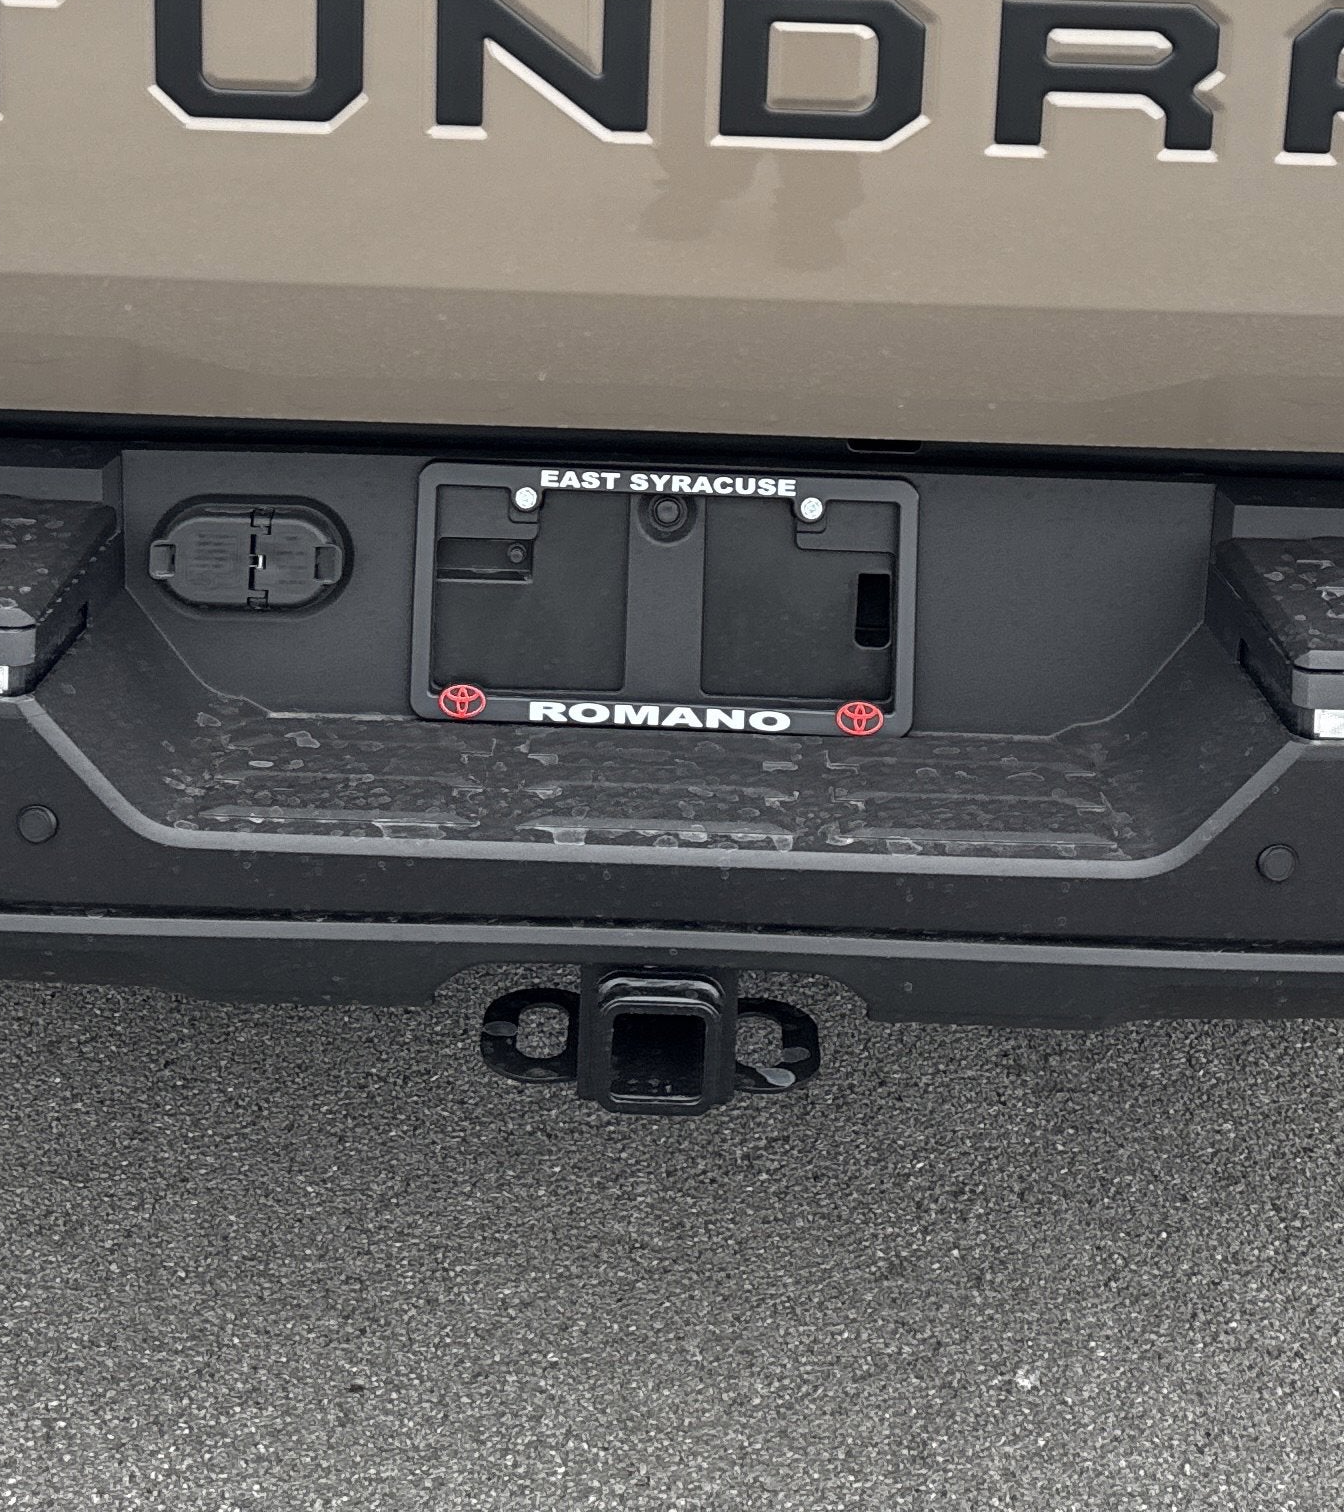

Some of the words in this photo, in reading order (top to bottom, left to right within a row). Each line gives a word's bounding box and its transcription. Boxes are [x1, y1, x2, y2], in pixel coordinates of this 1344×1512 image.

[540, 469, 621, 490] EAST
[629, 473, 797, 497] SYRACUSE
[528, 701, 791, 732] ROMANO
